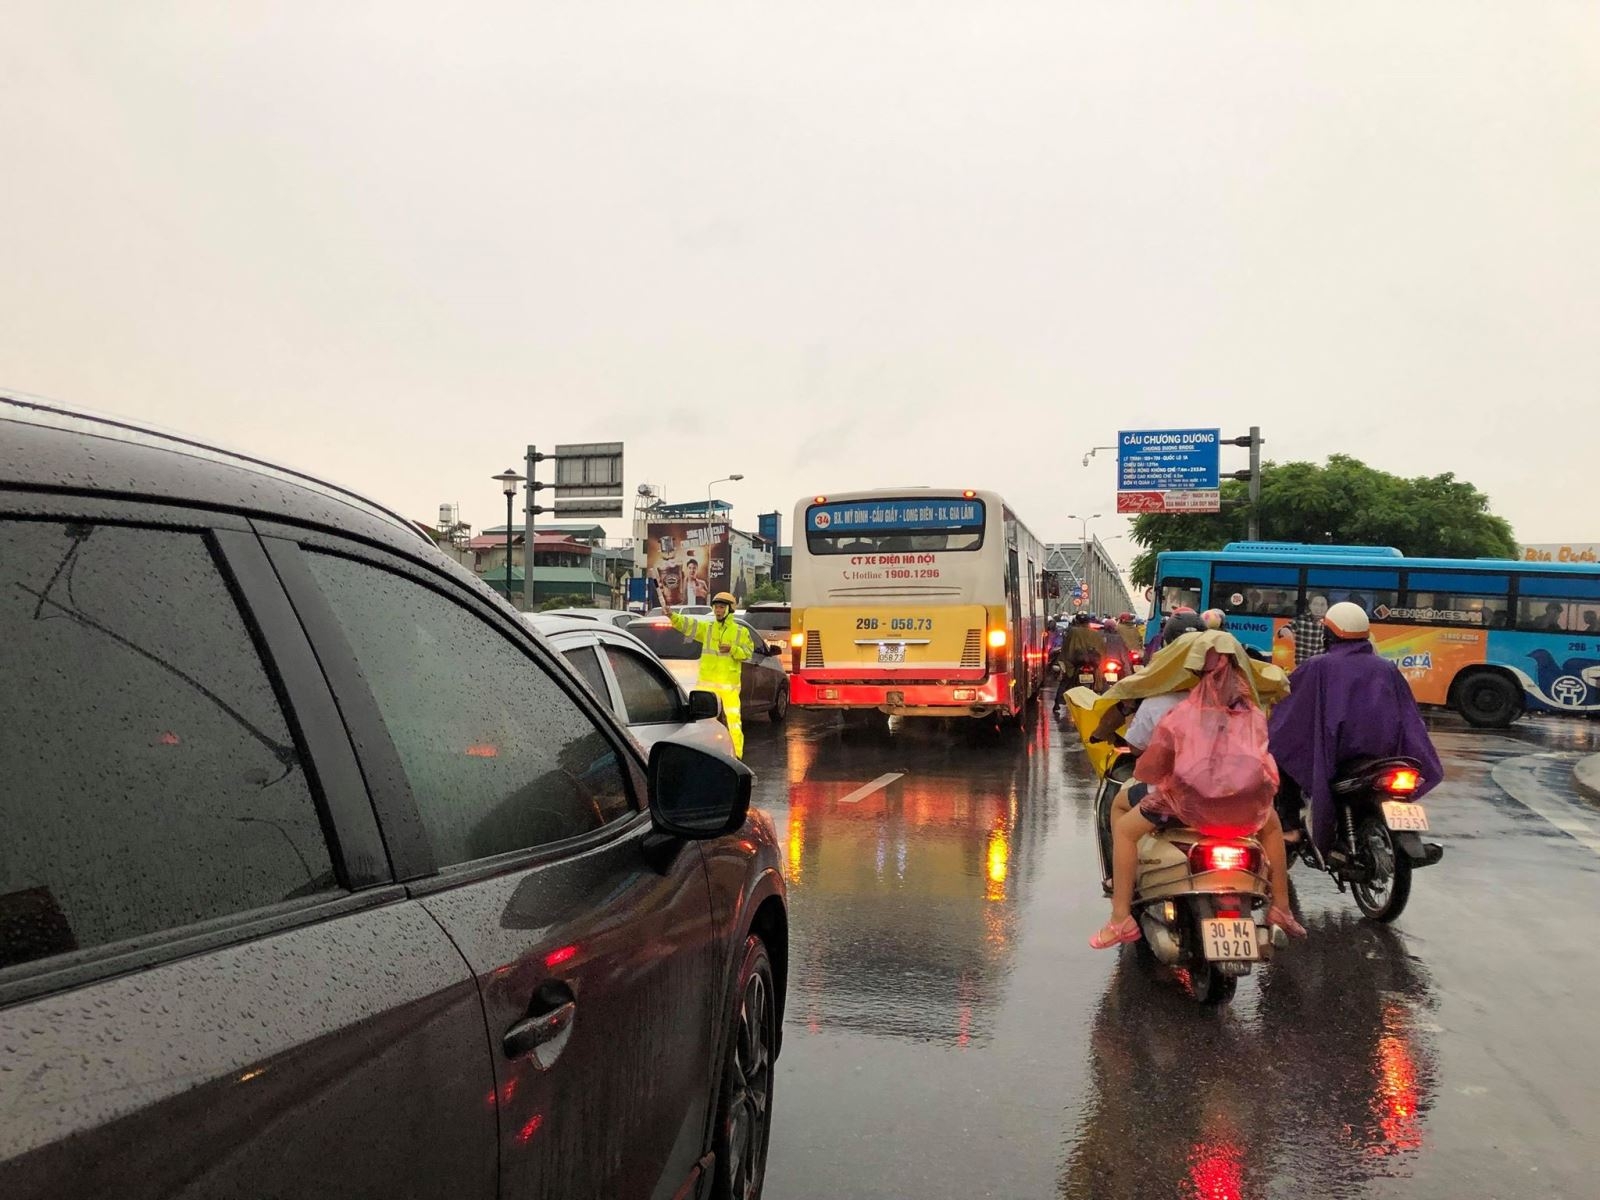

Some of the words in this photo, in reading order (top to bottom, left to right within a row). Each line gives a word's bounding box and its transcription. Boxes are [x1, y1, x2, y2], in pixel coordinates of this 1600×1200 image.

[1144, 434, 1180, 444] CHƯƠNG
[1183, 433, 1214, 444] DƯƠNG
[903, 509, 918, 522] LONG
[949, 508, 960, 520] GIA
[961, 504, 974, 520] LÂM
[816, 515, 829, 525] 34
[851, 556, 863, 565] CT
[865, 556, 876, 565] XE
[852, 571, 882, 579] Hotline
[885, 570, 939, 579] 1900.1296
[1402, 652, 1431, 668] QUÀ
[1213, 940, 1251, 956] 1920
